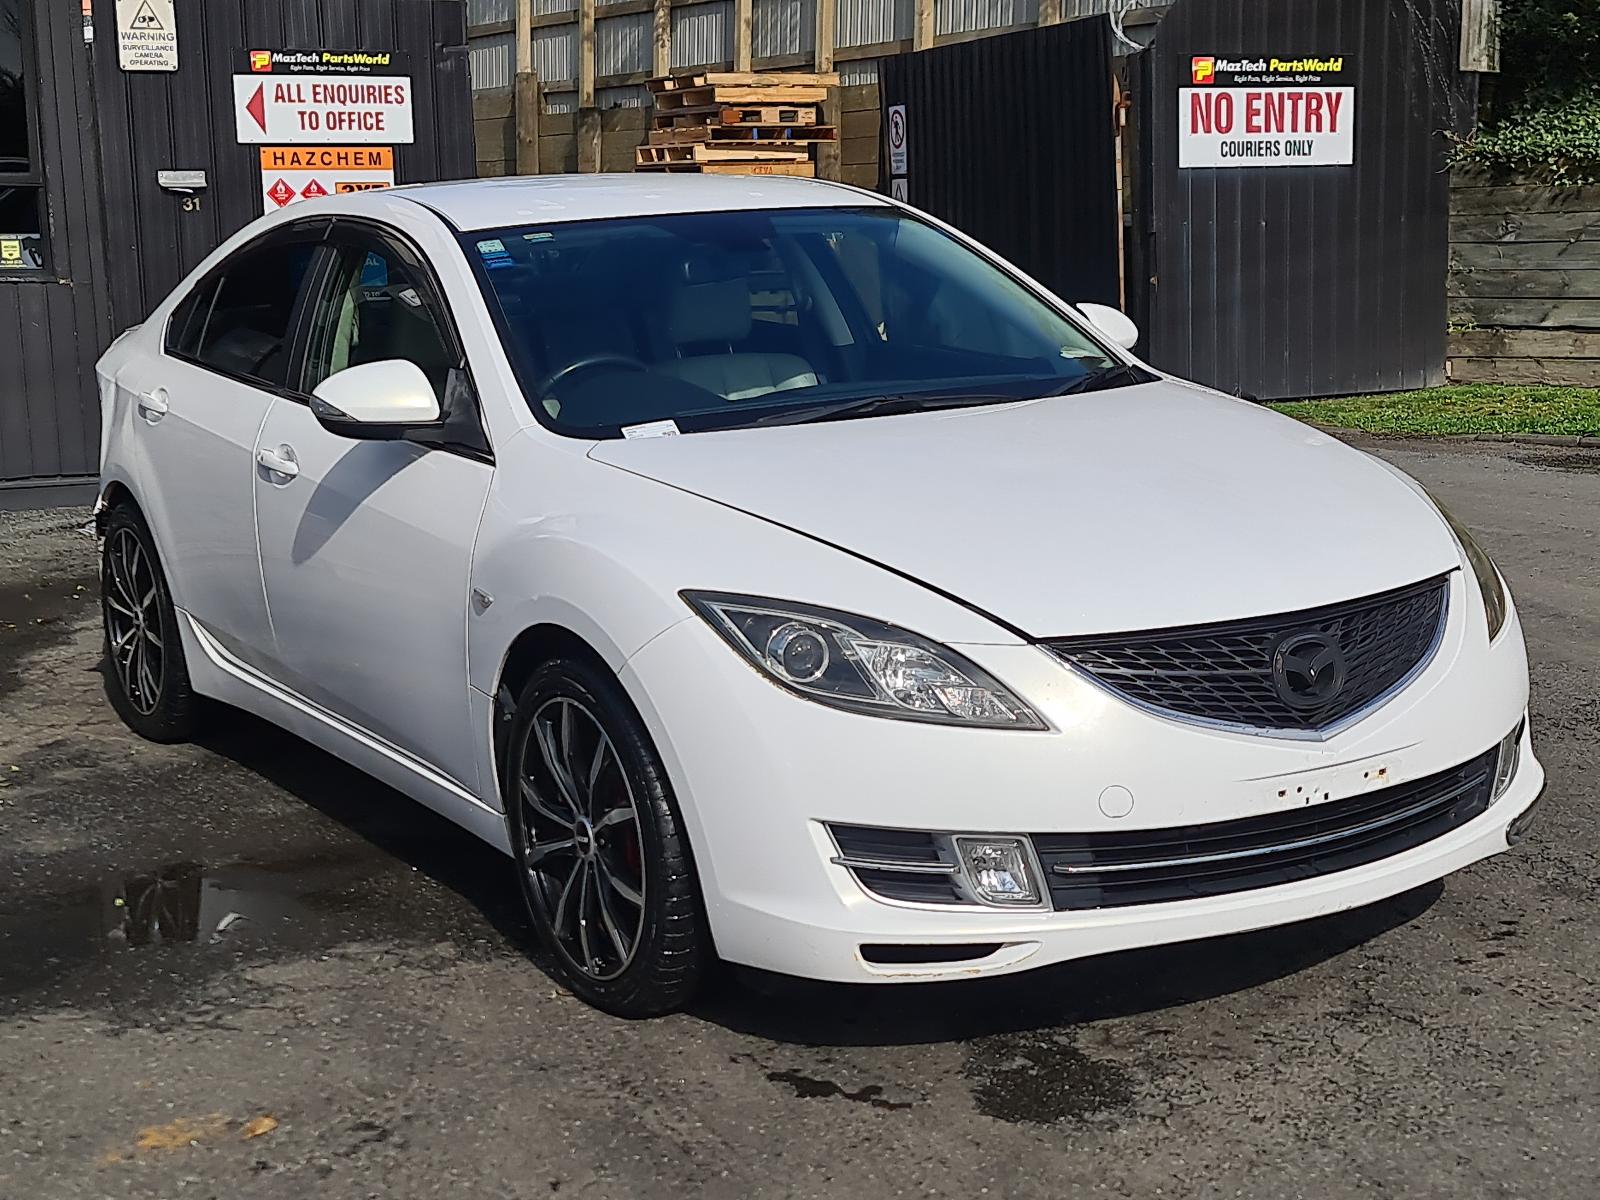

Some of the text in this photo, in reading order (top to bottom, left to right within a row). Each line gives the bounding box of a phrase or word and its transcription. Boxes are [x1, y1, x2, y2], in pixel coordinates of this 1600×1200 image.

[121, 32, 175, 41] WARNING
[322, 53, 390, 65] PartsWorld
[1215, 57, 1343, 72] MazTech PartsWorld
[274, 83, 405, 106] ALL ENQUIRIES
[1190, 92, 1343, 134] NO ENTRY
[297, 111, 385, 131] TO OFFICE
[1220, 140, 1313, 157] COURIERS ONLY
[273, 151, 382, 166] HAZCHEM
[182, 197, 200, 211] 31
